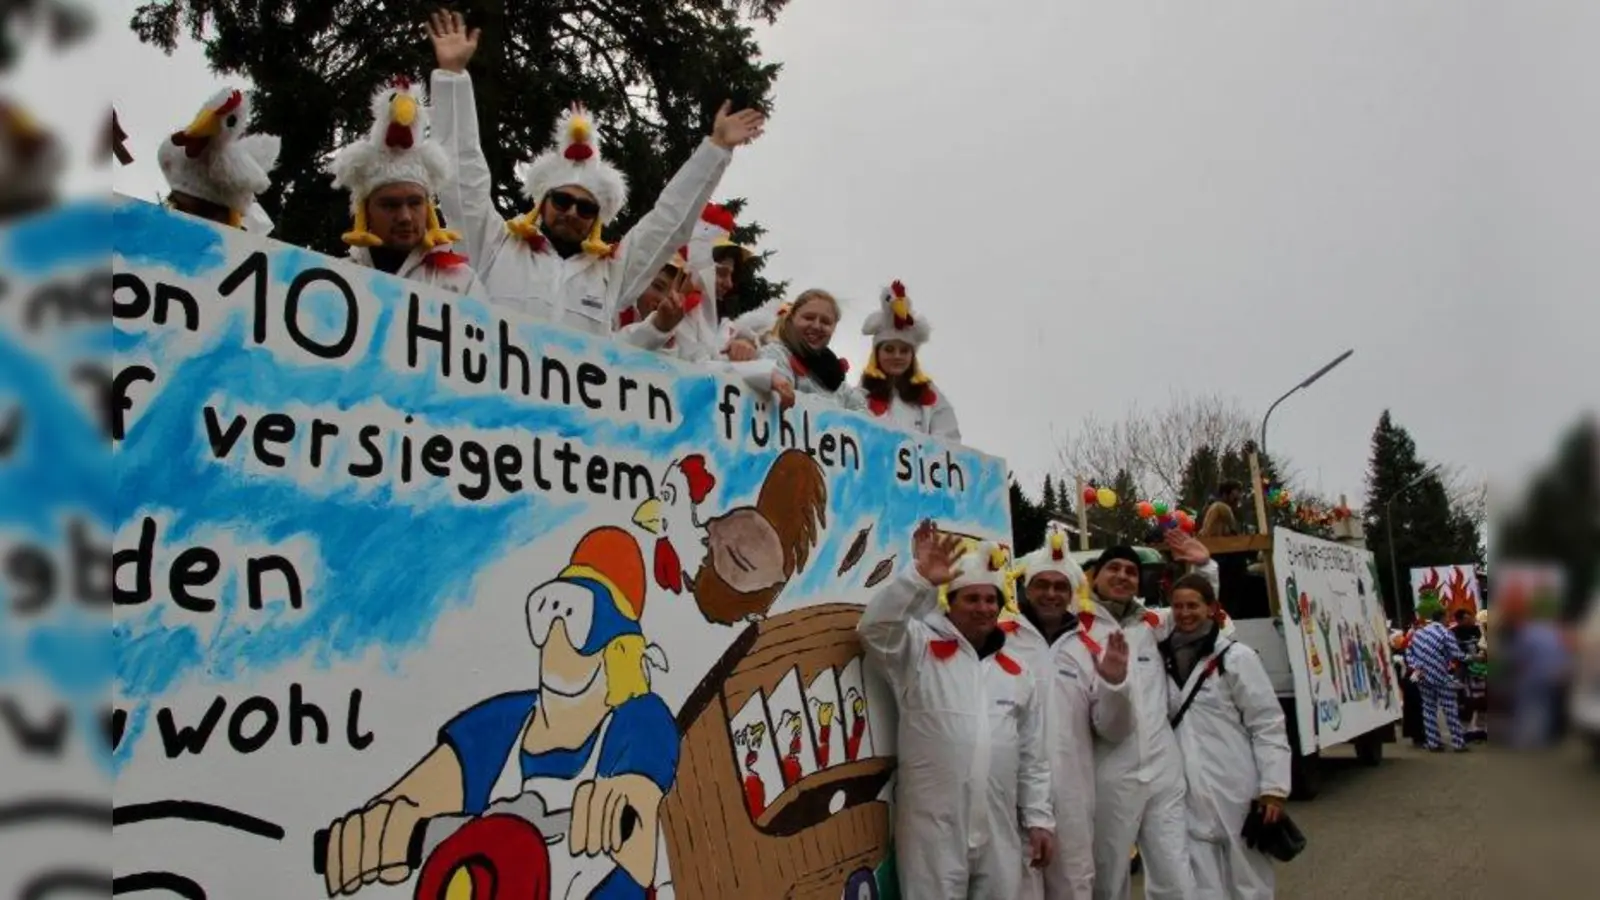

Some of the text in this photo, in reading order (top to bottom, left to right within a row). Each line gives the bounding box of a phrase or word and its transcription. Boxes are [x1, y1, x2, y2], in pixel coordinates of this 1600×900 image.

[203, 406, 656, 504] versiegeltem
[217, 251, 359, 359] 10
[406, 292, 672, 423] Hühnern
[718, 384, 860, 471] fühlen
[896, 444, 965, 492] sich
